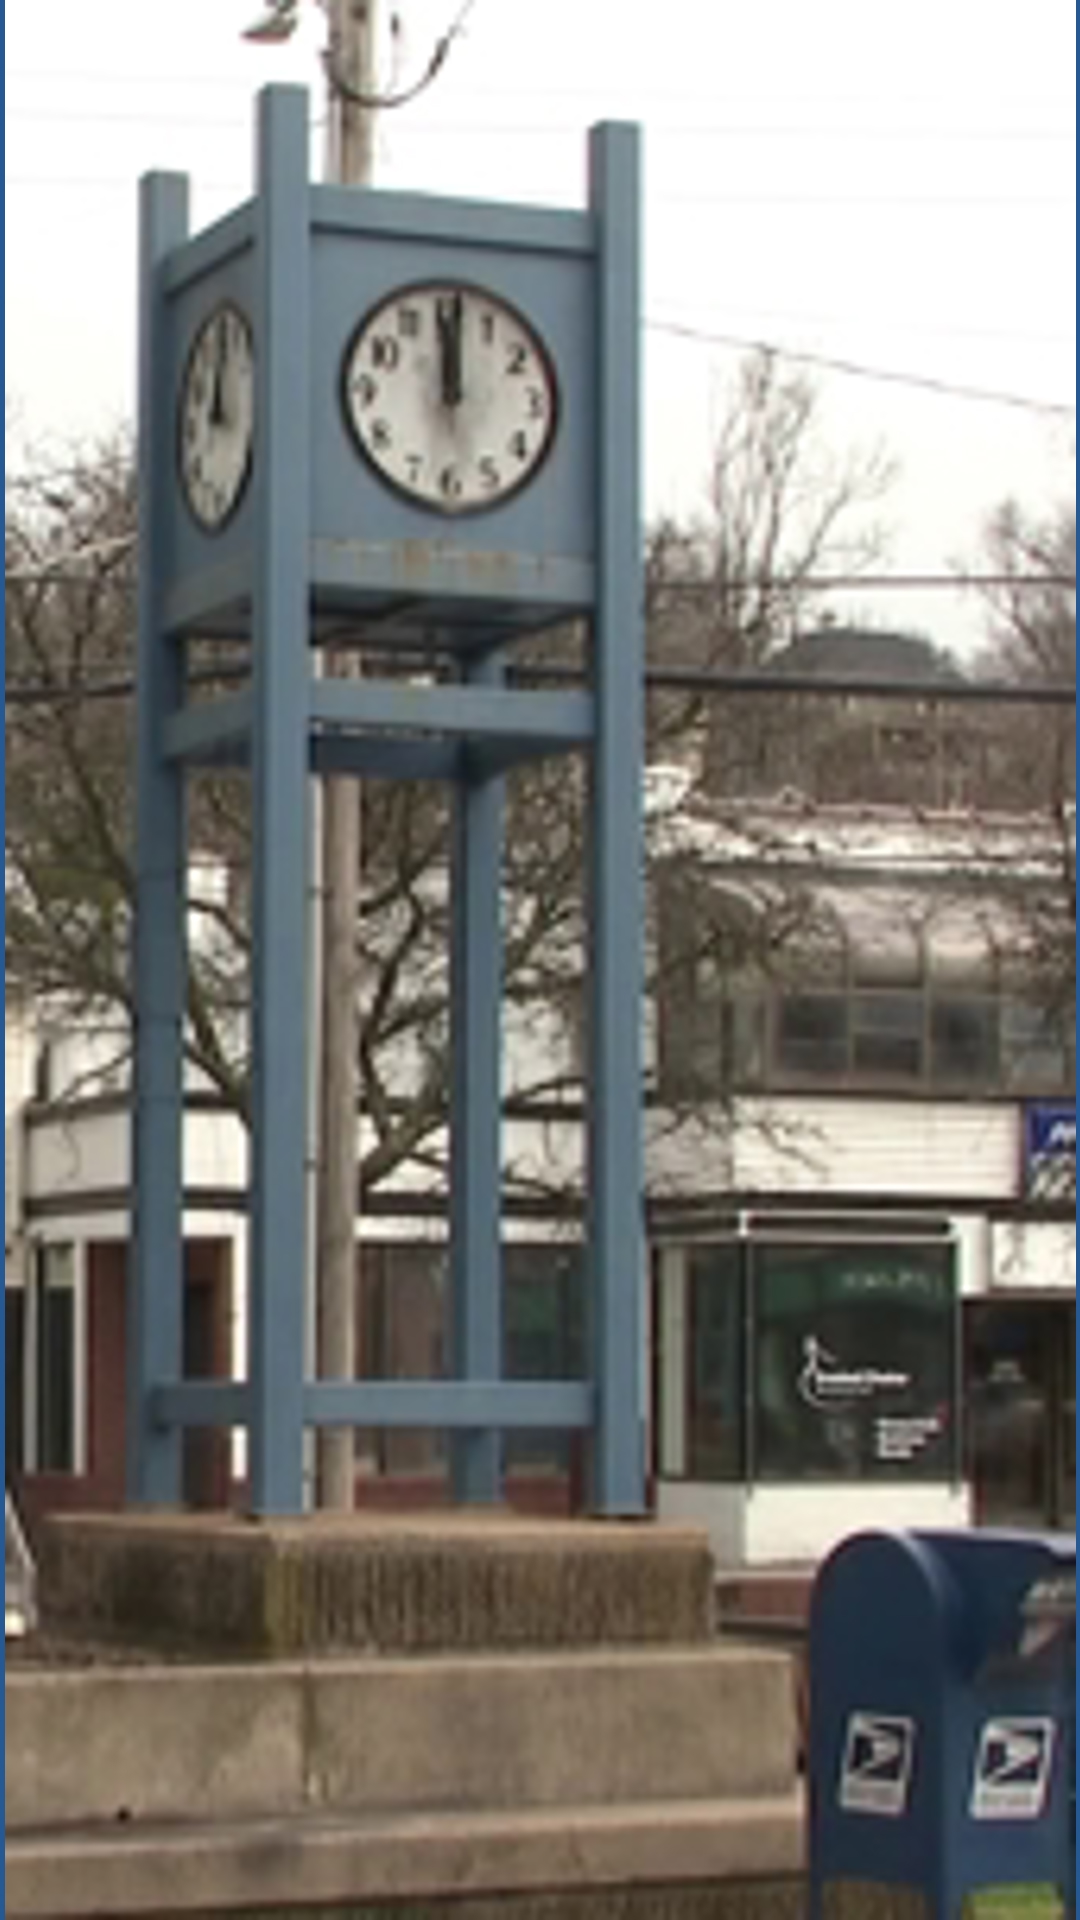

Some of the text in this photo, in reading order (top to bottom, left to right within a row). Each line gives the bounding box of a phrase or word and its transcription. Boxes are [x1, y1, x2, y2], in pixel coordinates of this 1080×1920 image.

[399, 308, 418, 338] 11
[481, 313, 494, 345] 1
[371, 335, 399, 371] 10
[505, 341, 526, 375] 2
[353, 373, 376, 411] 9
[525, 386, 544, 419] 3
[371, 418, 392, 450] 8
[508, 430, 527, 463] 4
[405, 453, 423, 483] 7
[439, 465, 462, 497] 6
[479, 456, 501, 488] 5
